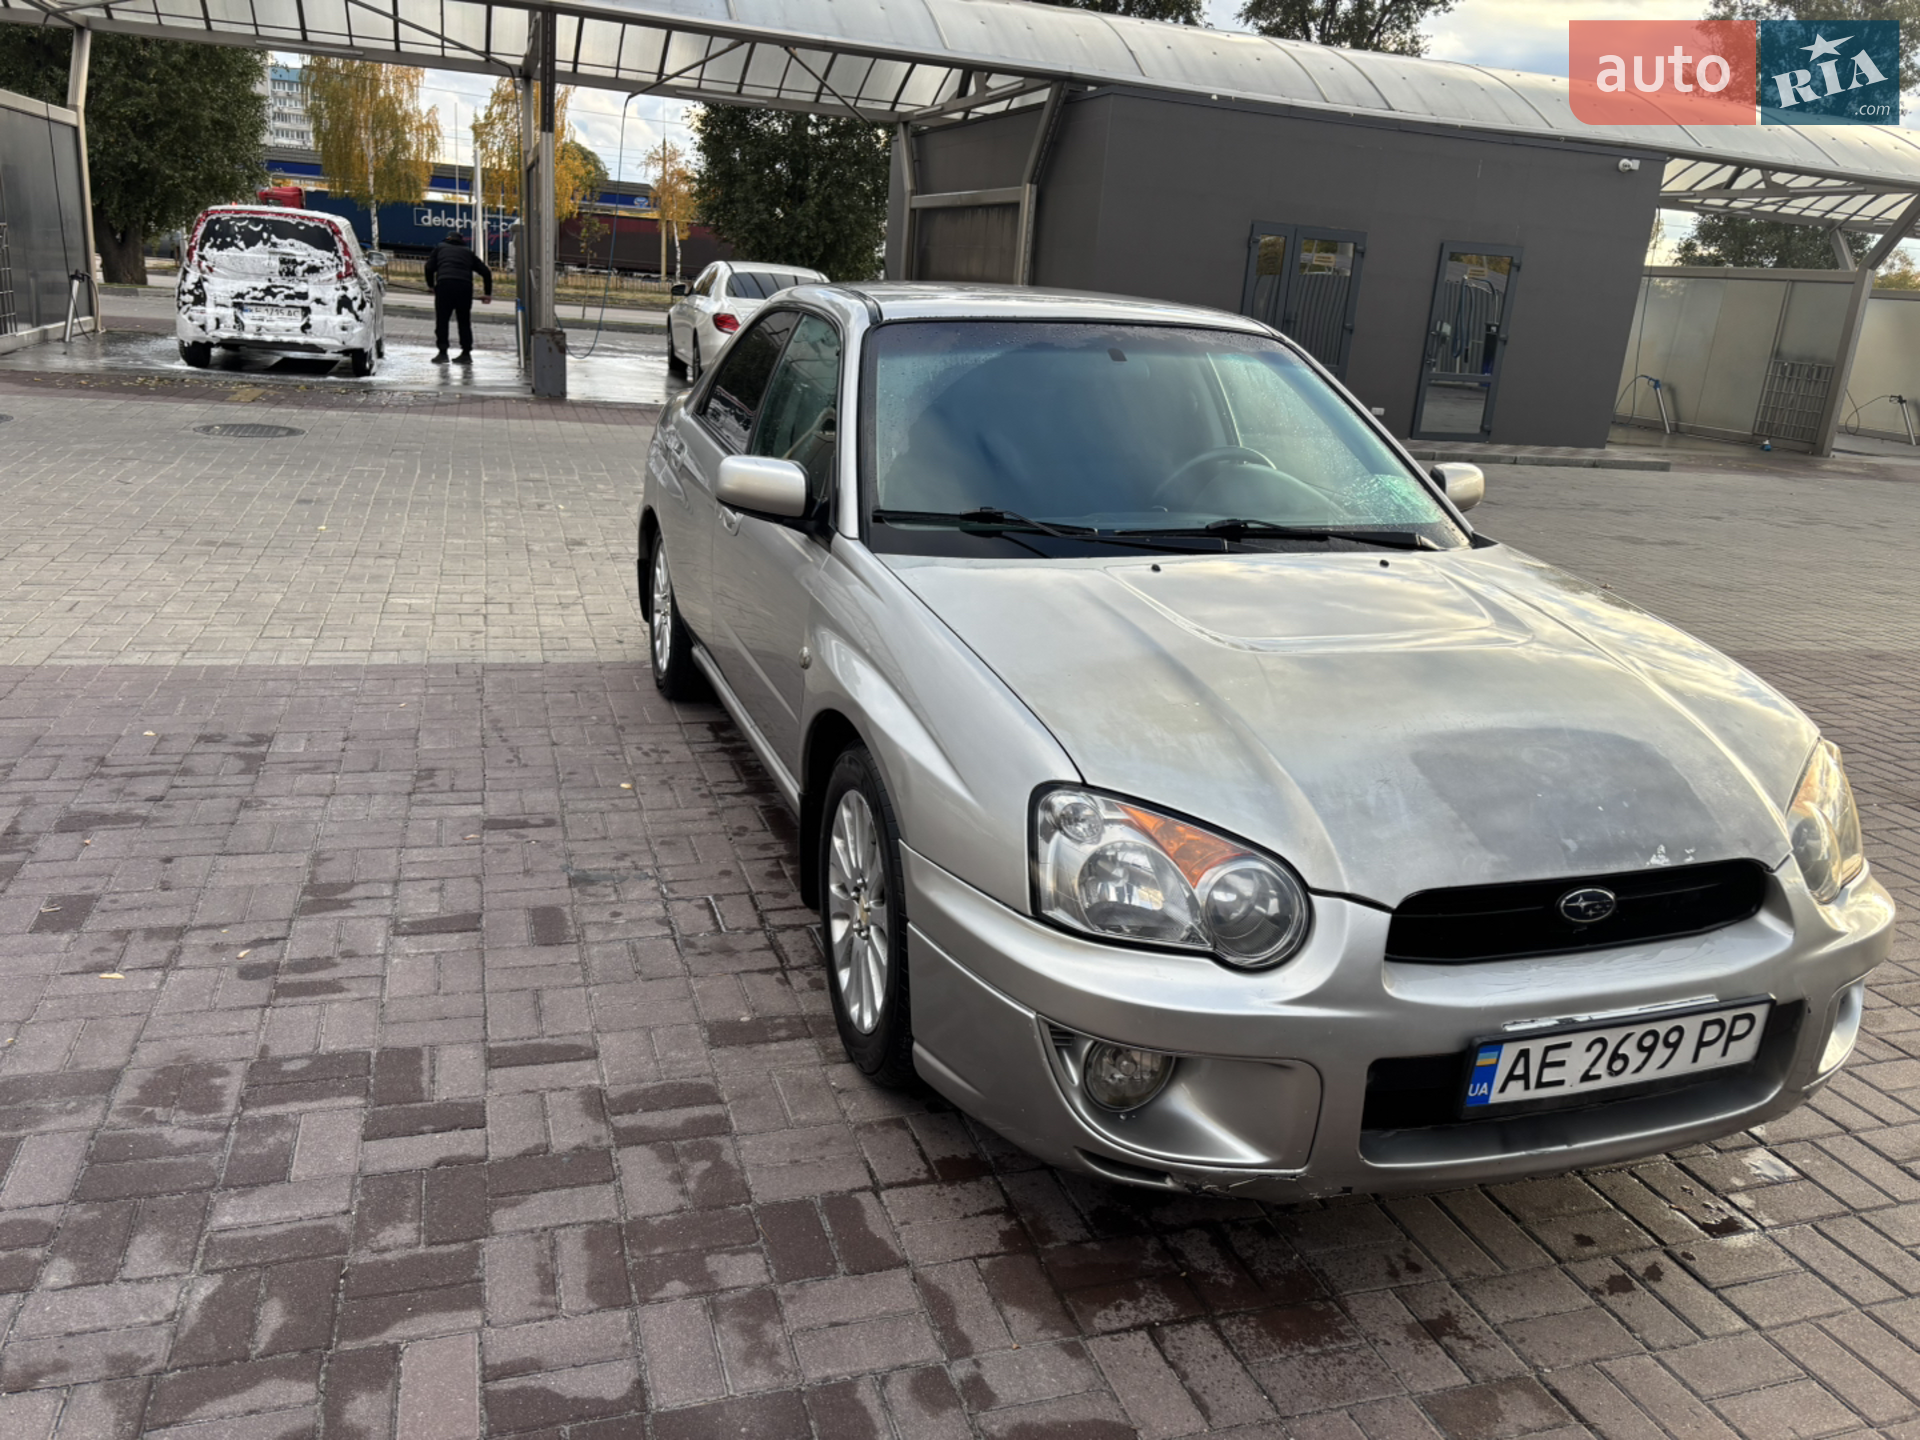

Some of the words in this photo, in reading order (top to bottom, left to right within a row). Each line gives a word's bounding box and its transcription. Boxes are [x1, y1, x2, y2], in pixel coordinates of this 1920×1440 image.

[1498, 1041, 1573, 1094] AE
[1579, 1024, 1685, 1083] 2699
[1691, 1012, 1757, 1064] PP
[1467, 1082, 1489, 1097] UA
